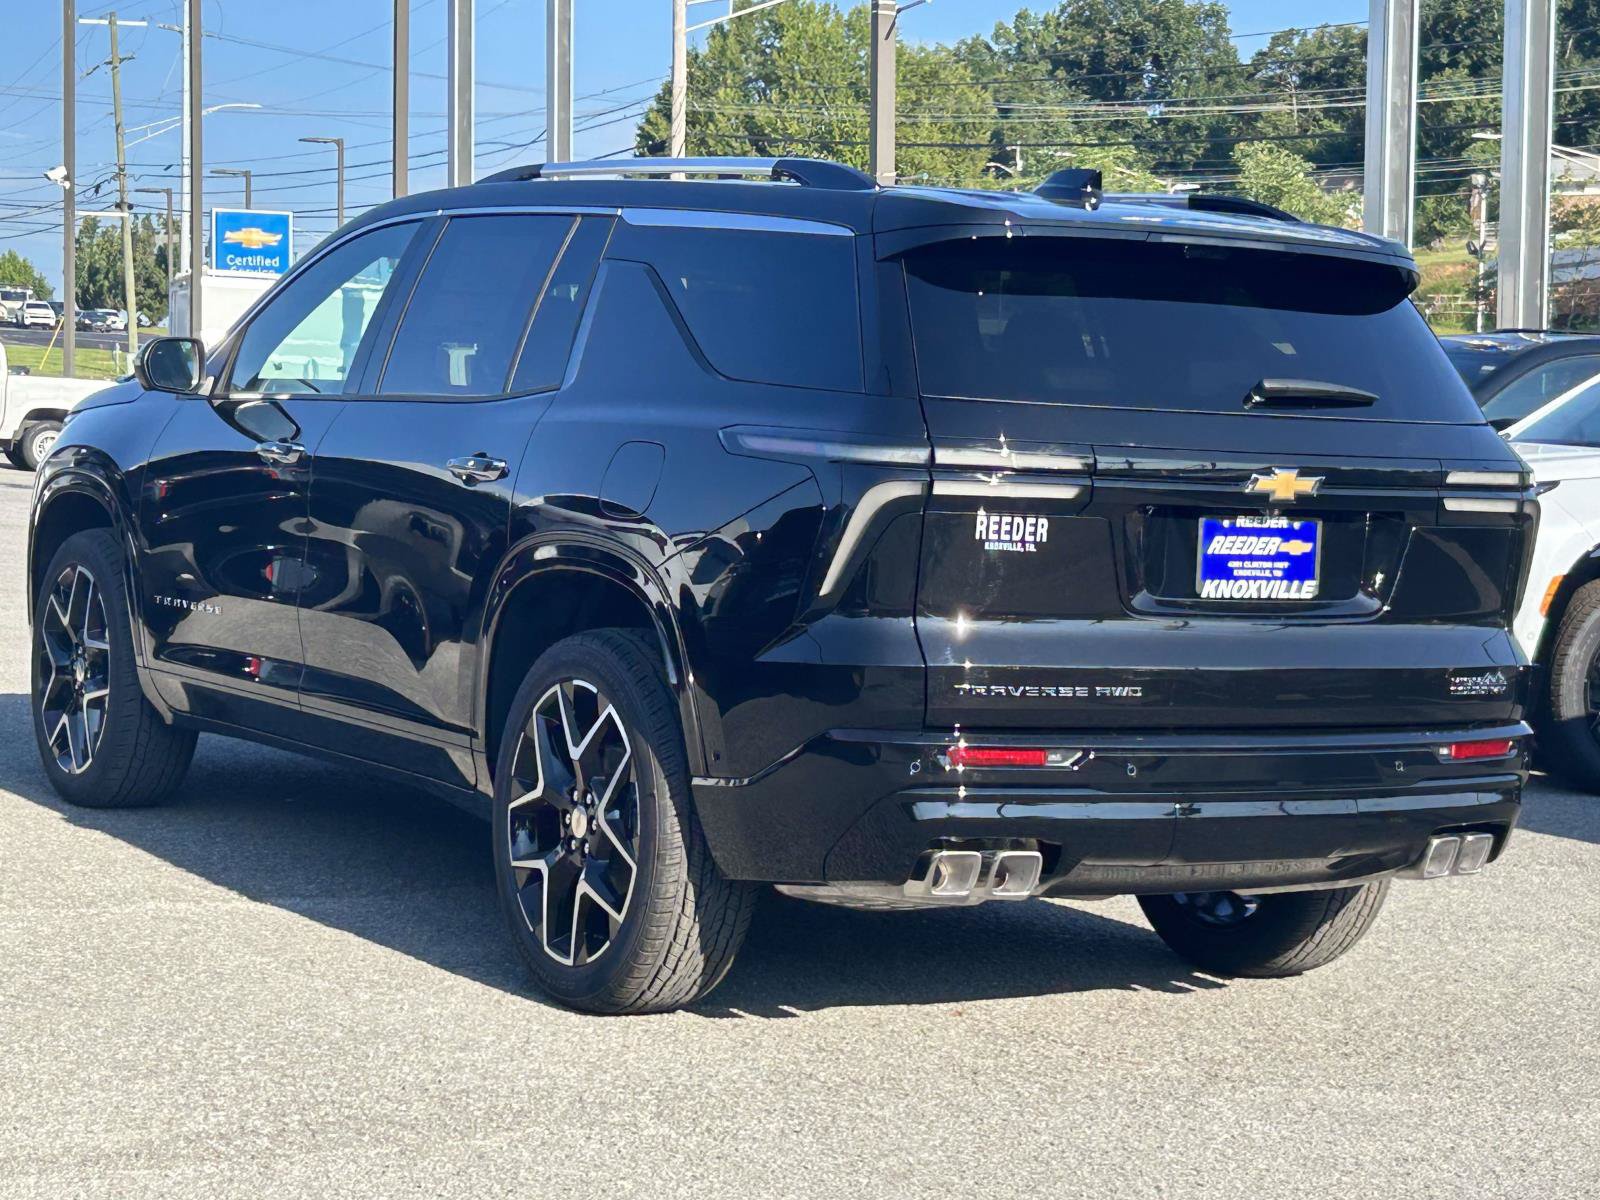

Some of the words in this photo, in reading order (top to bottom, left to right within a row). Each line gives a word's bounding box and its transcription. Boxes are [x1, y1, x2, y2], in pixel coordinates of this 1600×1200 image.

[226, 254, 280, 267] Certified
[975, 512, 1049, 542] REEDER
[1236, 515, 1288, 528] REEDER
[1207, 535, 1282, 555] REEDER
[1200, 579, 1318, 599] KNOXVILLE
[154, 595, 222, 615] TRAVERSE
[953, 683, 1089, 697] TRAVERSE
